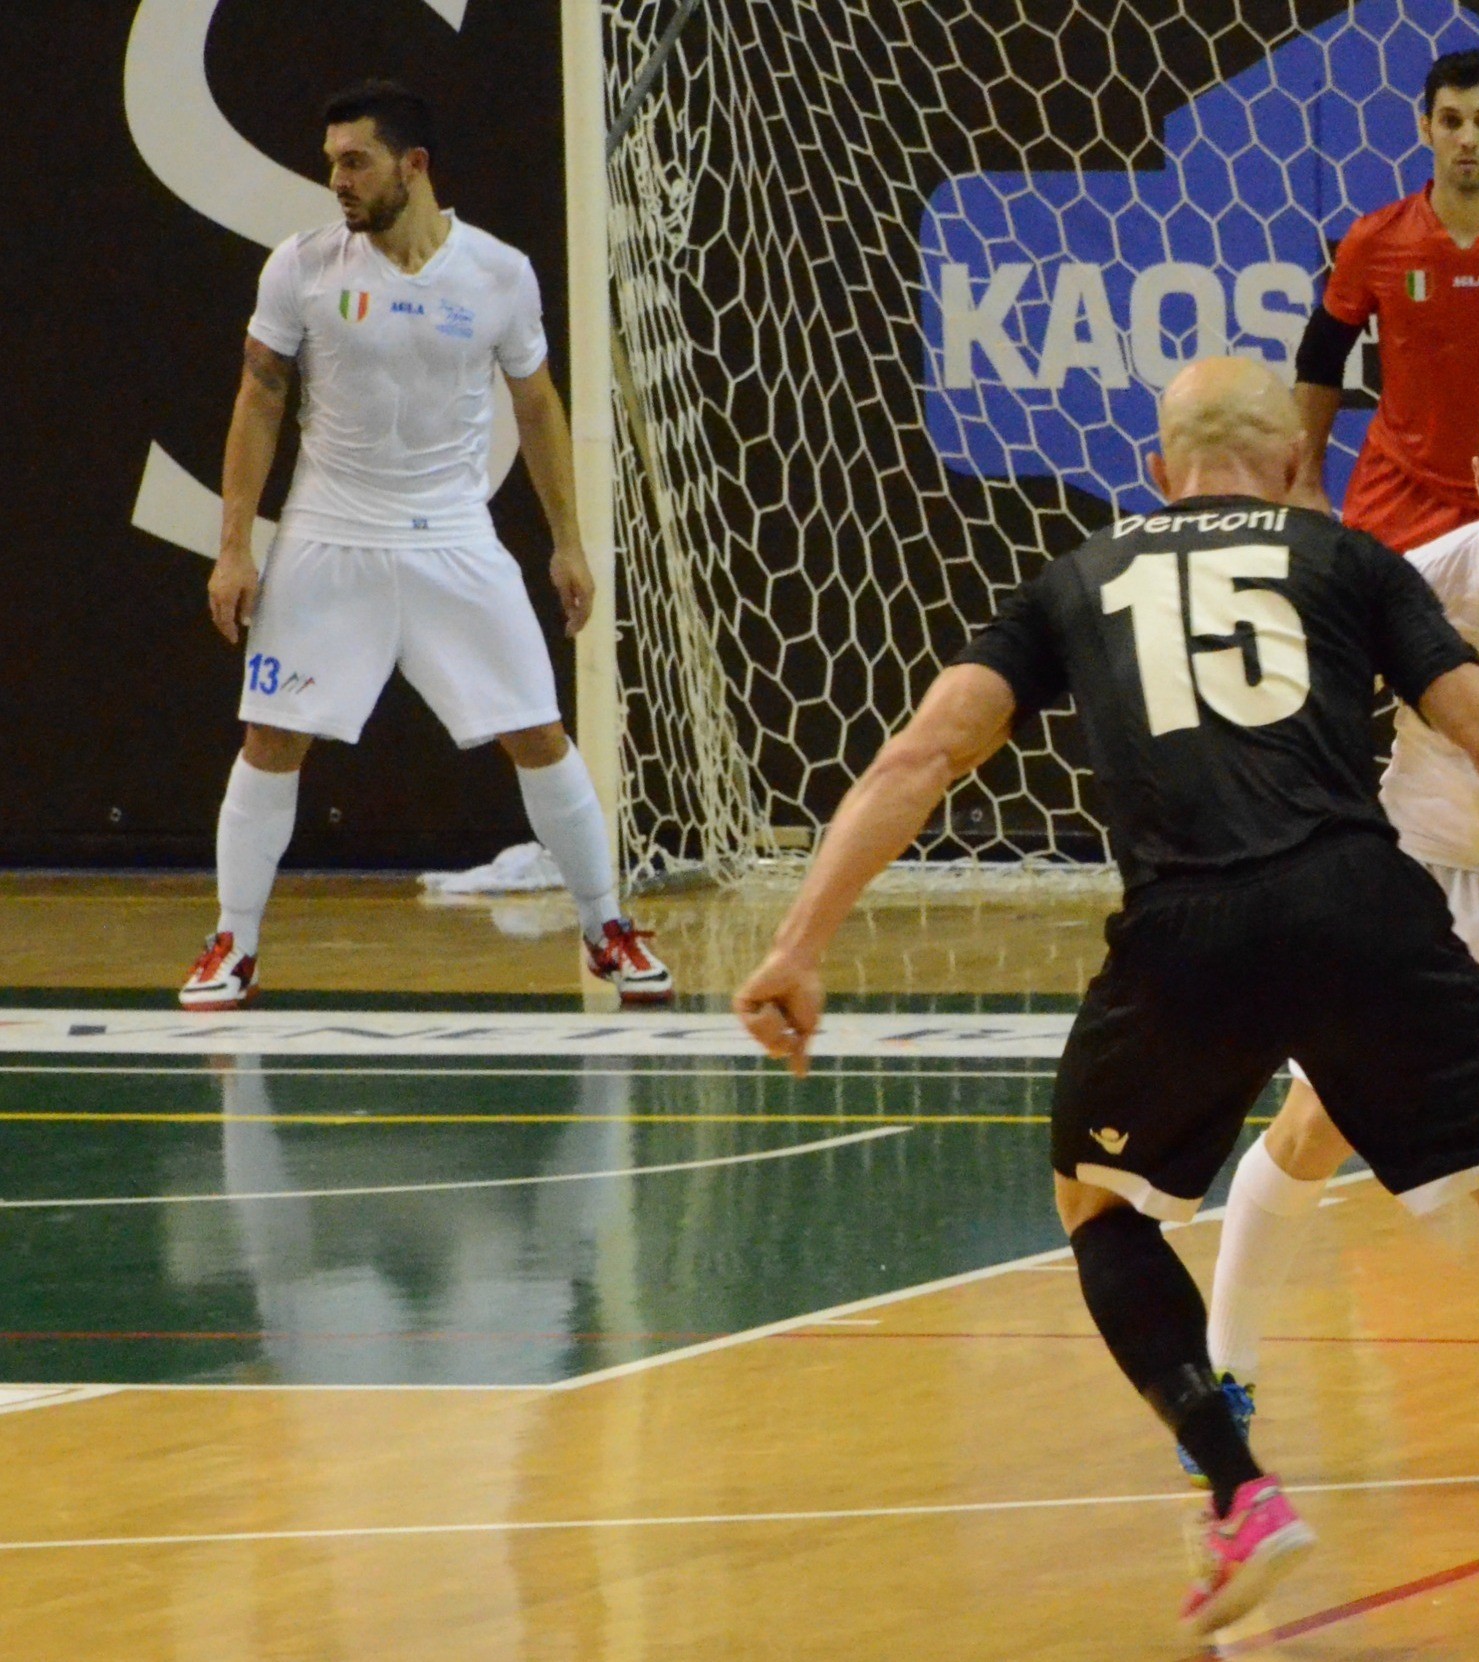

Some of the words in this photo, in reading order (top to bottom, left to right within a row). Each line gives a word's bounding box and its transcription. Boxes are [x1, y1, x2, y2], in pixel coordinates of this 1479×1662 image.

[939, 261, 1315, 389] KAOS
[249, 653, 281, 695] 13
[1100, 545, 1310, 737] 15
